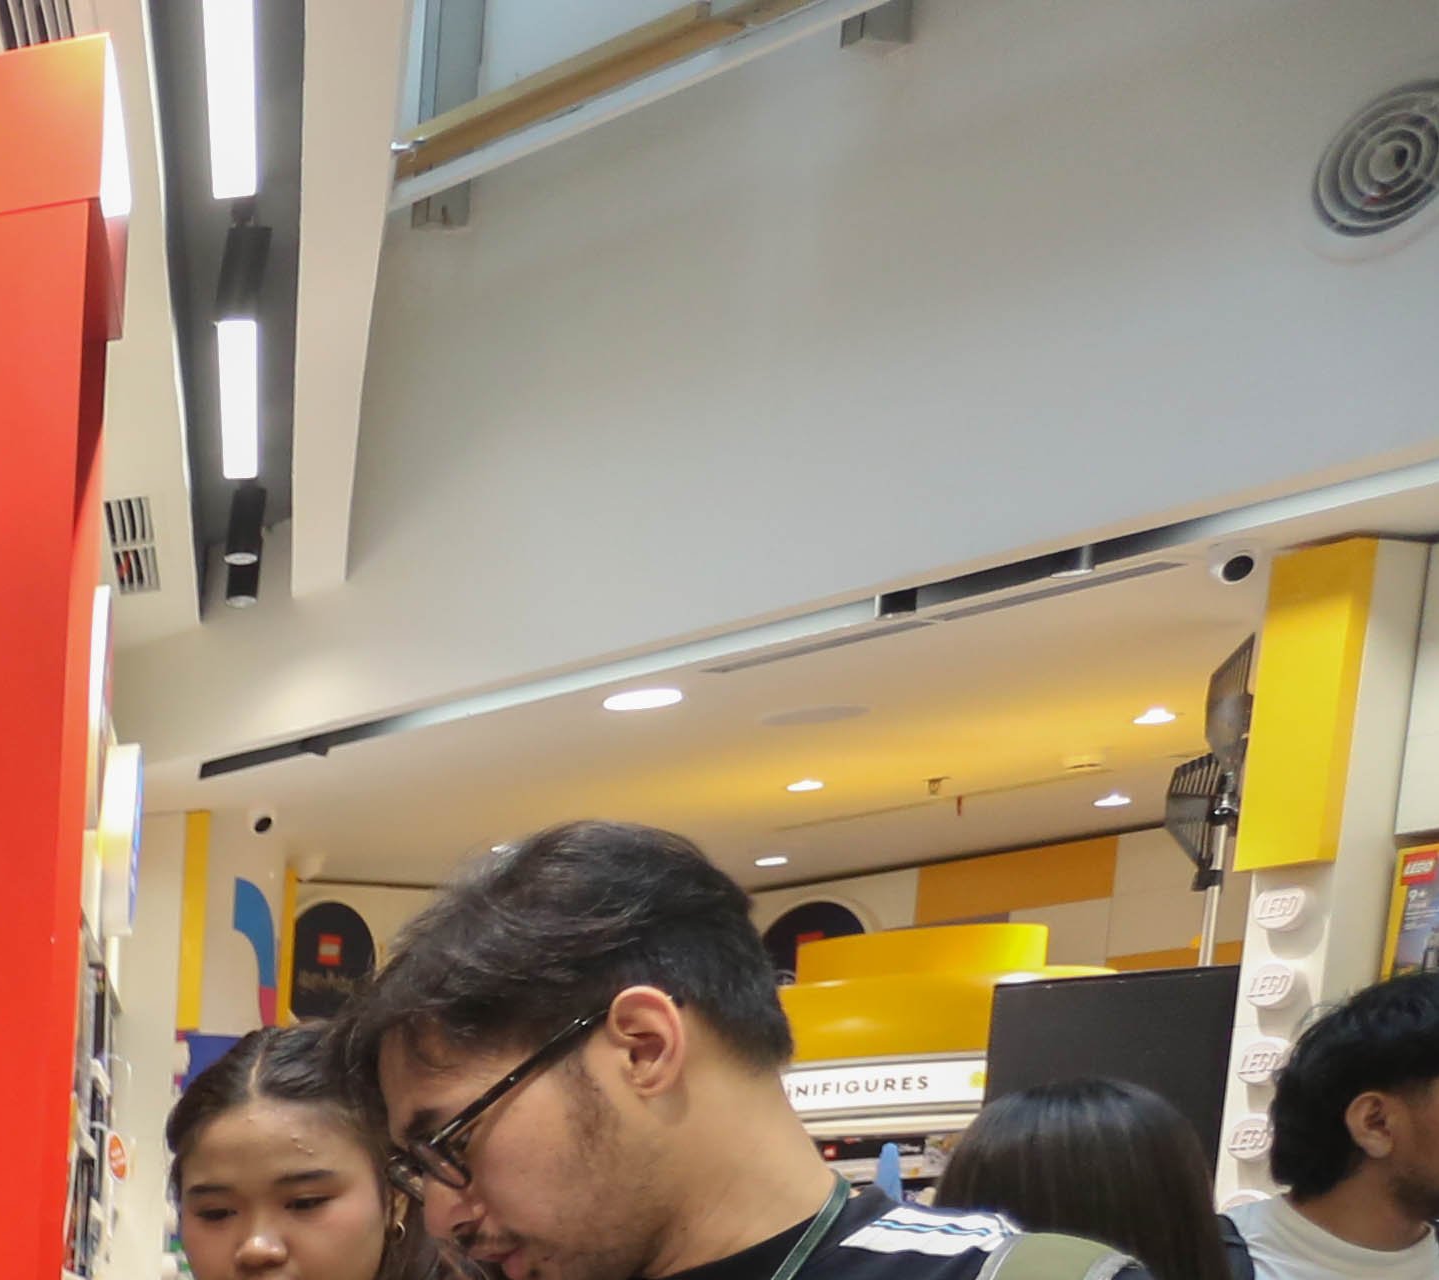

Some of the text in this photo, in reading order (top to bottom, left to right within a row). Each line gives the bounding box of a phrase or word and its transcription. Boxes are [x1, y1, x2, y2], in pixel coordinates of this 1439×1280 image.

[1404, 861, 1434, 876] LEGO
[1256, 896, 1299, 920] LEGO
[1247, 974, 1287, 998] LEGO
[1238, 1053, 1279, 1075] LEGO
[786, 1076, 929, 1098] INIFIGURES
[1229, 1127, 1272, 1151] LEGO
